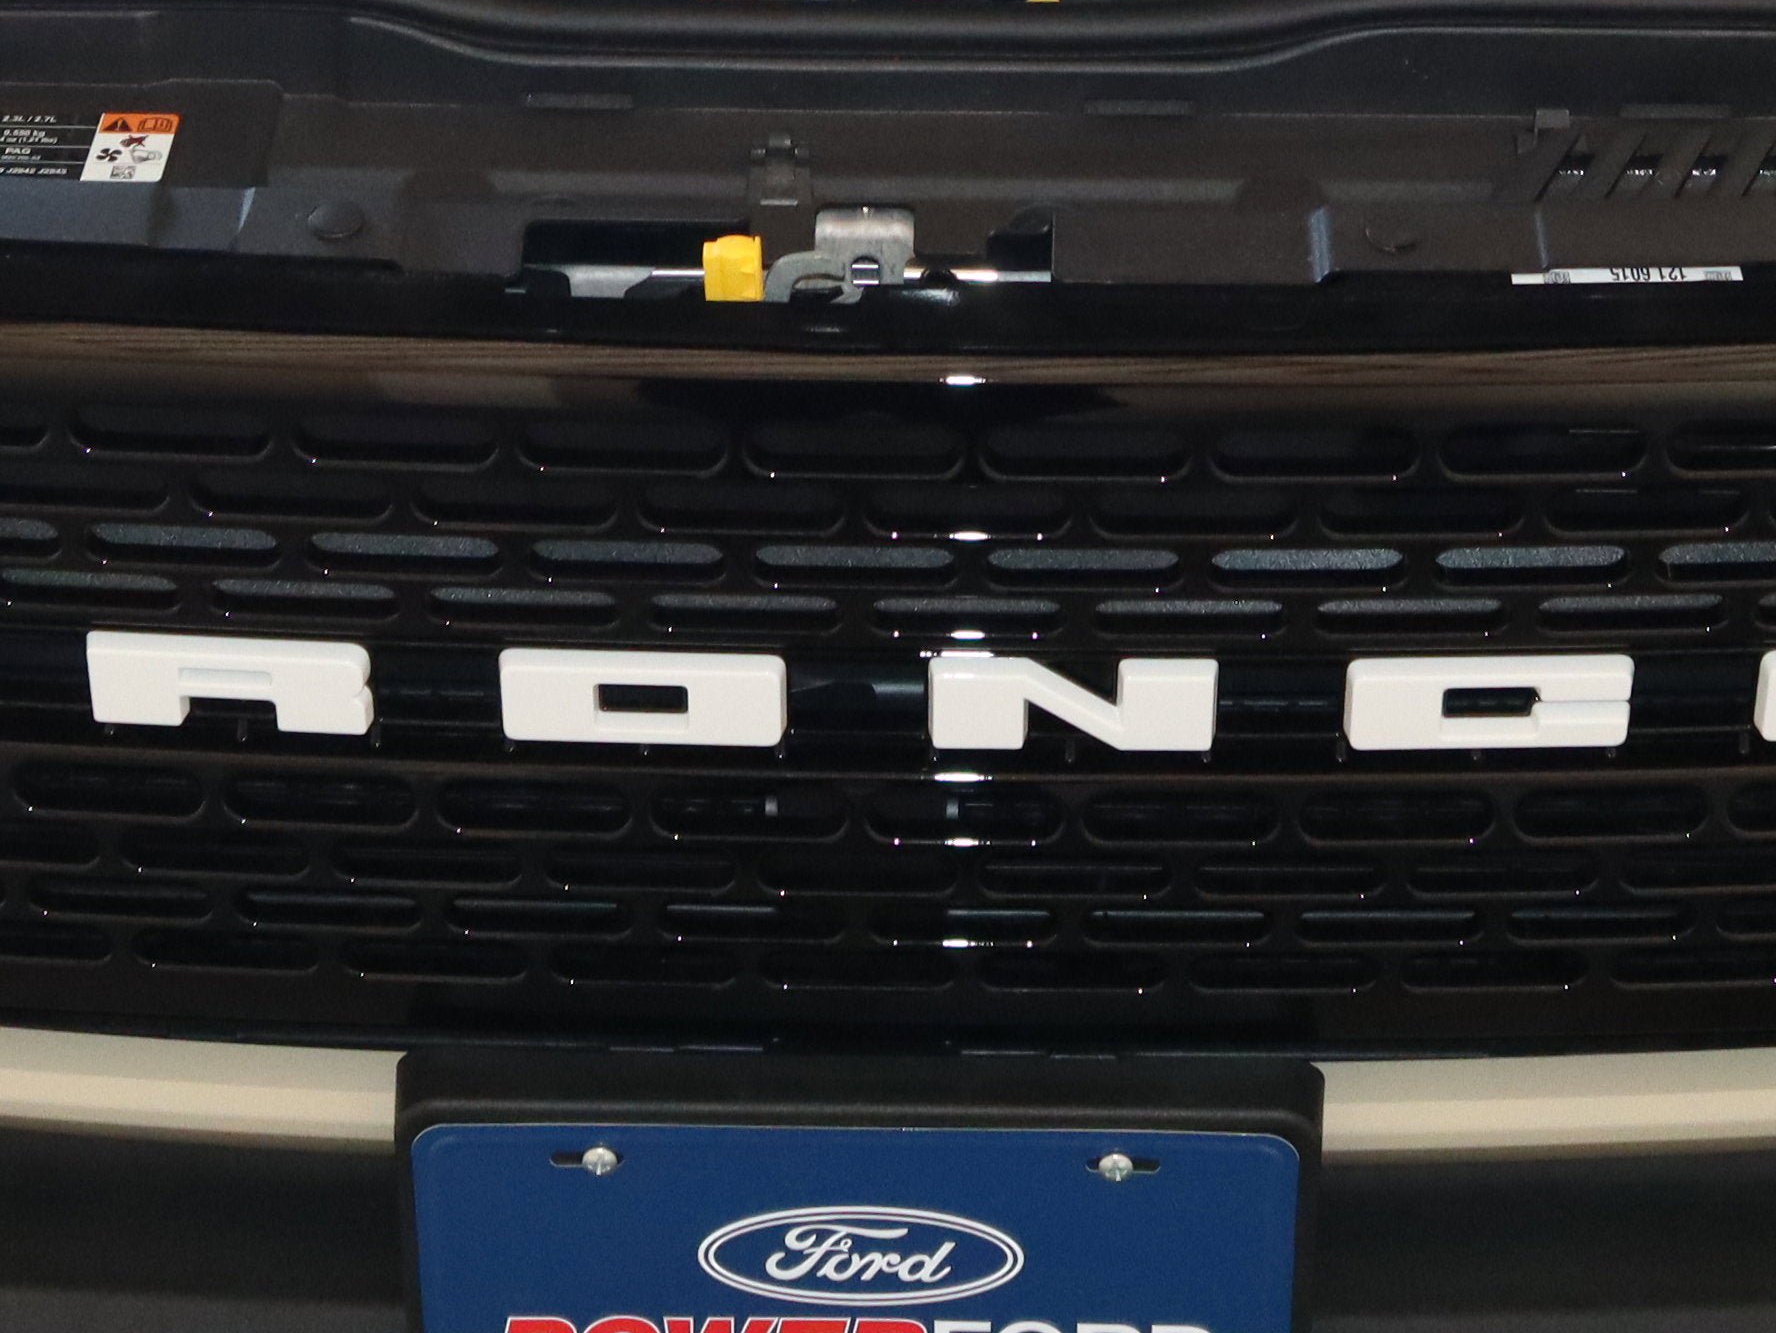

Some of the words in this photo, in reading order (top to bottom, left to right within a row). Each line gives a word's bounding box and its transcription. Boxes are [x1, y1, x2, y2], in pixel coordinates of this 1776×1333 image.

[1, 115, 25, 123] 2.3L
[33, 115, 57, 123] 2.7L
[764, 1223, 957, 1284] Ford
